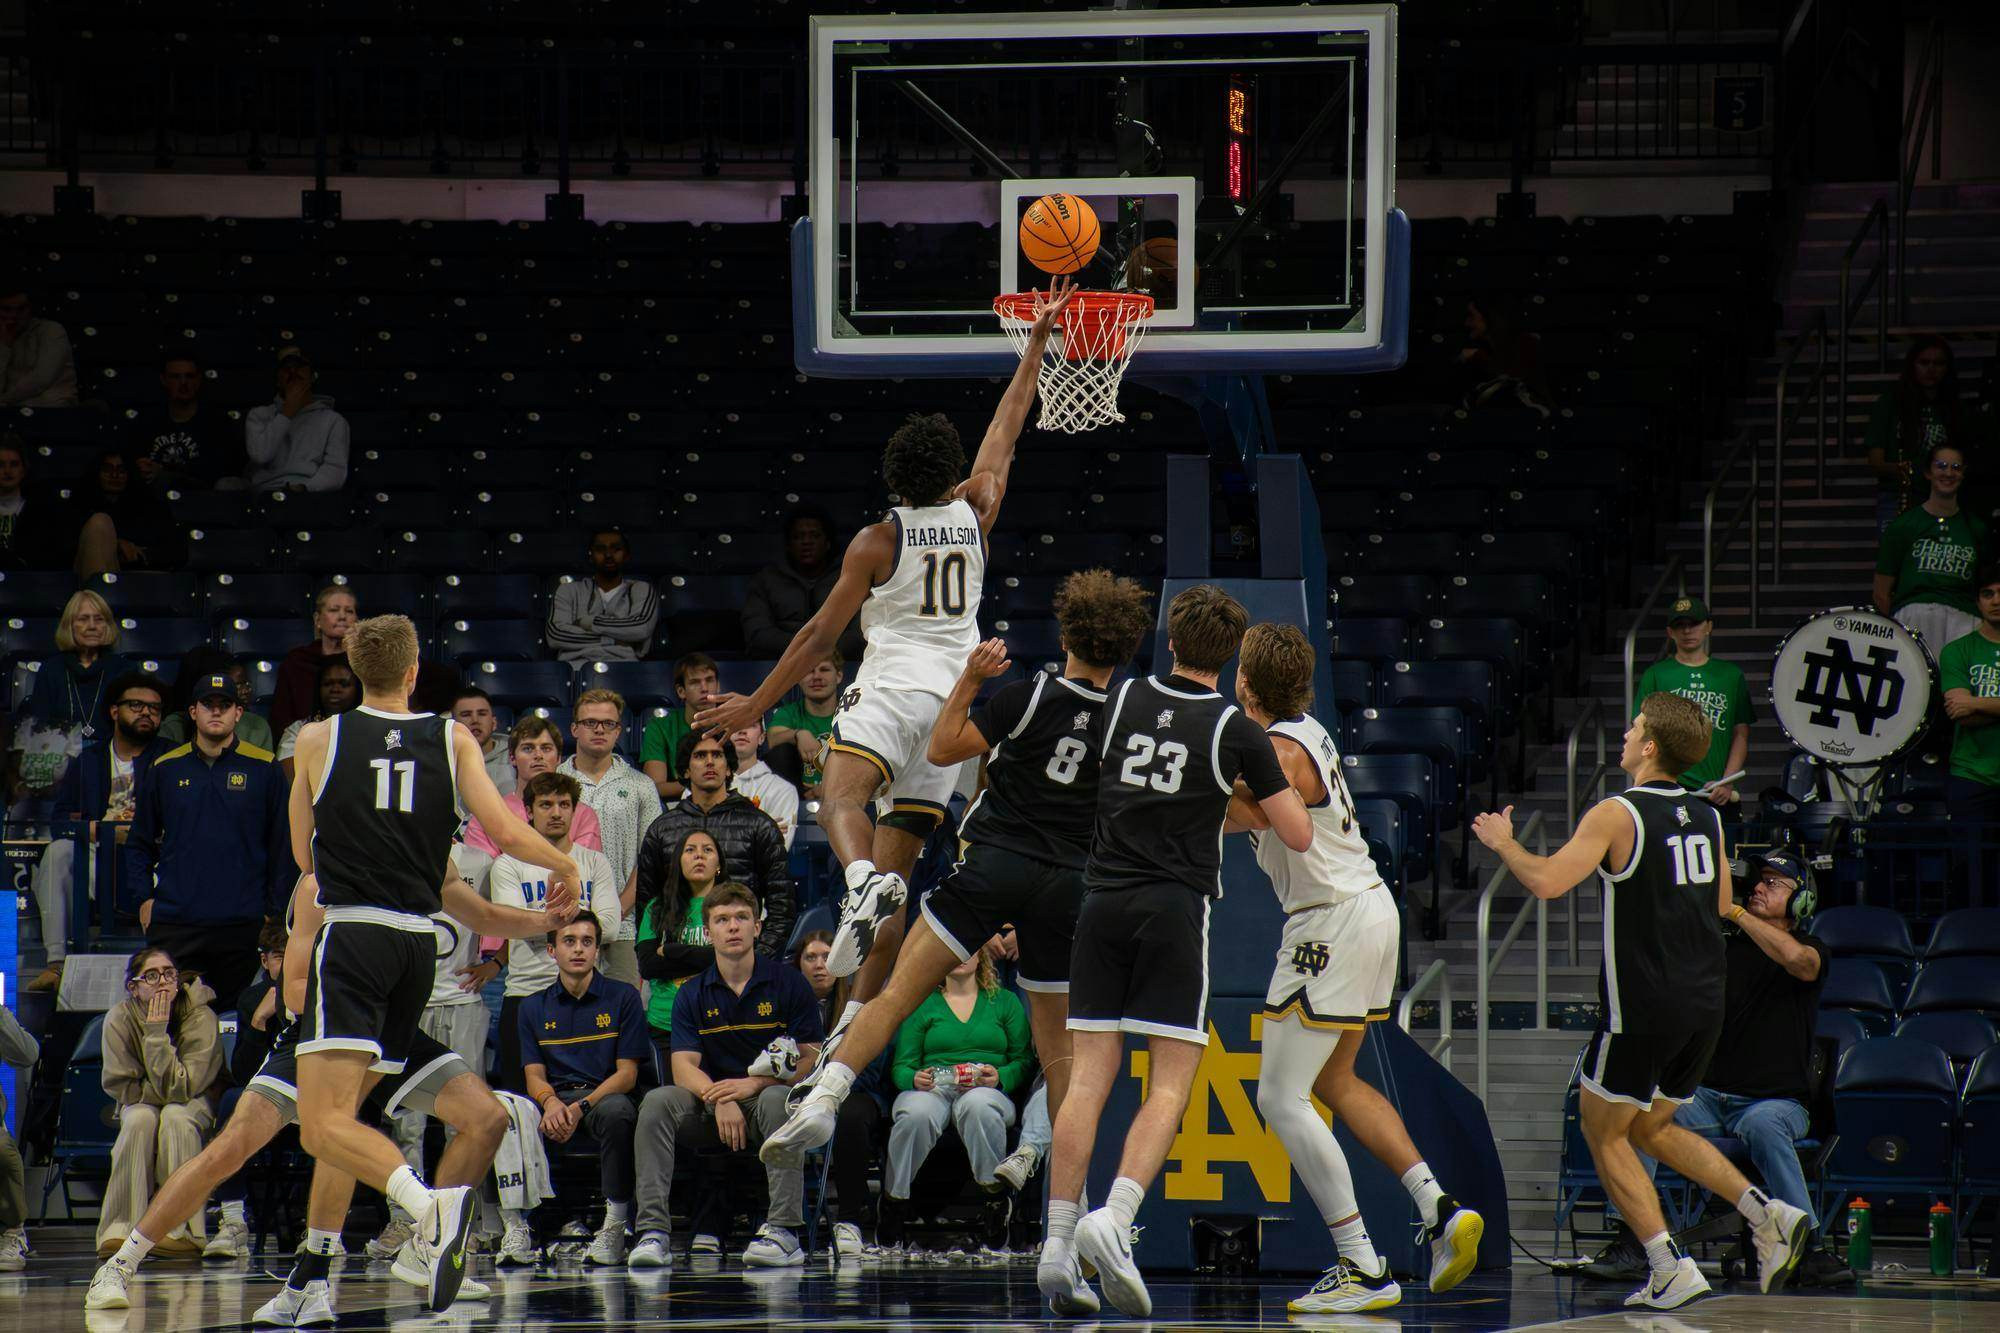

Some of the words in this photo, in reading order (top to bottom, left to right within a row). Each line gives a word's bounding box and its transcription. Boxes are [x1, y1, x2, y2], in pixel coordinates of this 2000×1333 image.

[906, 527, 978, 546] HARALSON
[920, 551, 966, 617] 10
[1917, 552, 1974, 580] IRISH
[1849, 620, 1894, 640] YAMAHA
[1795, 637, 1905, 736] ND
[369, 758, 415, 813] 11
[1045, 736, 1088, 785] 8
[1120, 733, 1189, 794] 23
[1666, 834, 1716, 885] 10
[1292, 941, 1330, 977] ND
